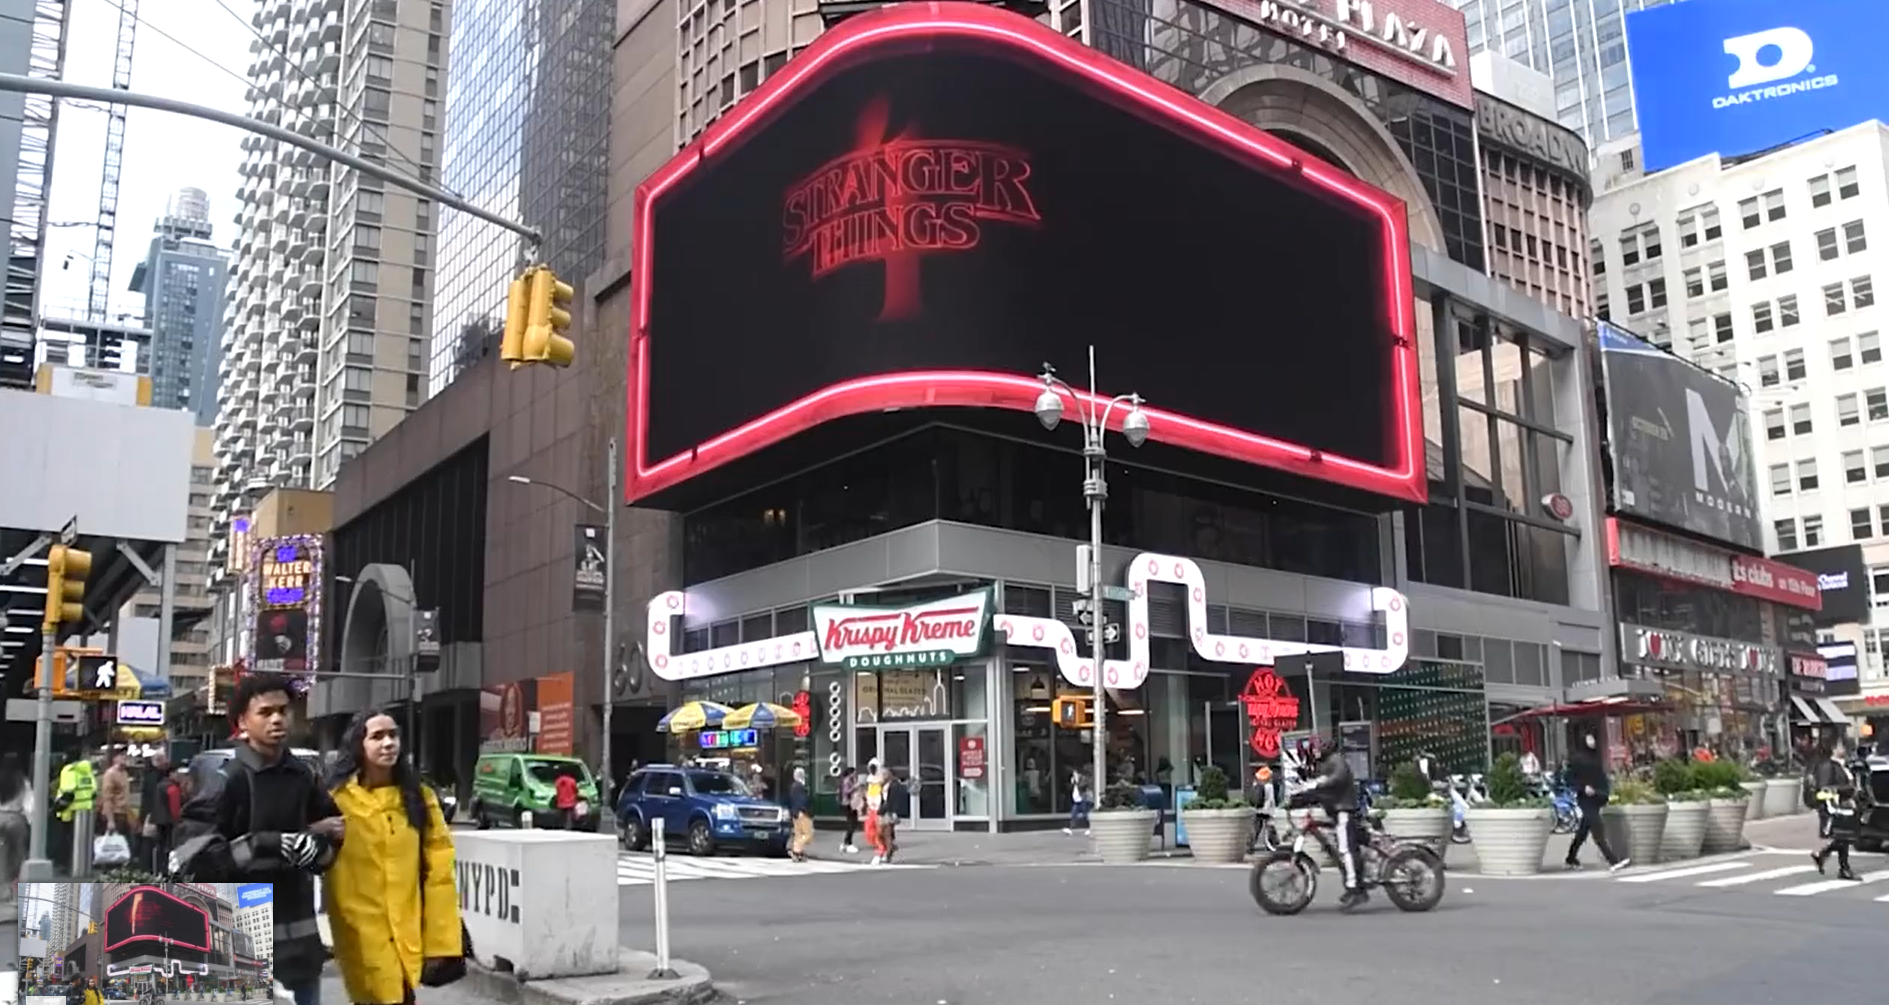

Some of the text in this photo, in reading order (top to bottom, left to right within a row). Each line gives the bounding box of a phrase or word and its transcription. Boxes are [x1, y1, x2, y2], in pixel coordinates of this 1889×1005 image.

[1712, 74, 1839, 109] DAKTRONICS
[782, 144, 1042, 252] STRANGER
[812, 202, 980, 274] THINGS
[1695, 491, 1751, 519] MODERN
[263, 561, 311, 575] WALTER
[268, 574, 304, 588] KERR
[825, 606, 979, 651] Krispy Kreme
[850, 651, 946, 668] DOUGHNUTS
[1253, 673, 1282, 694] HOT
